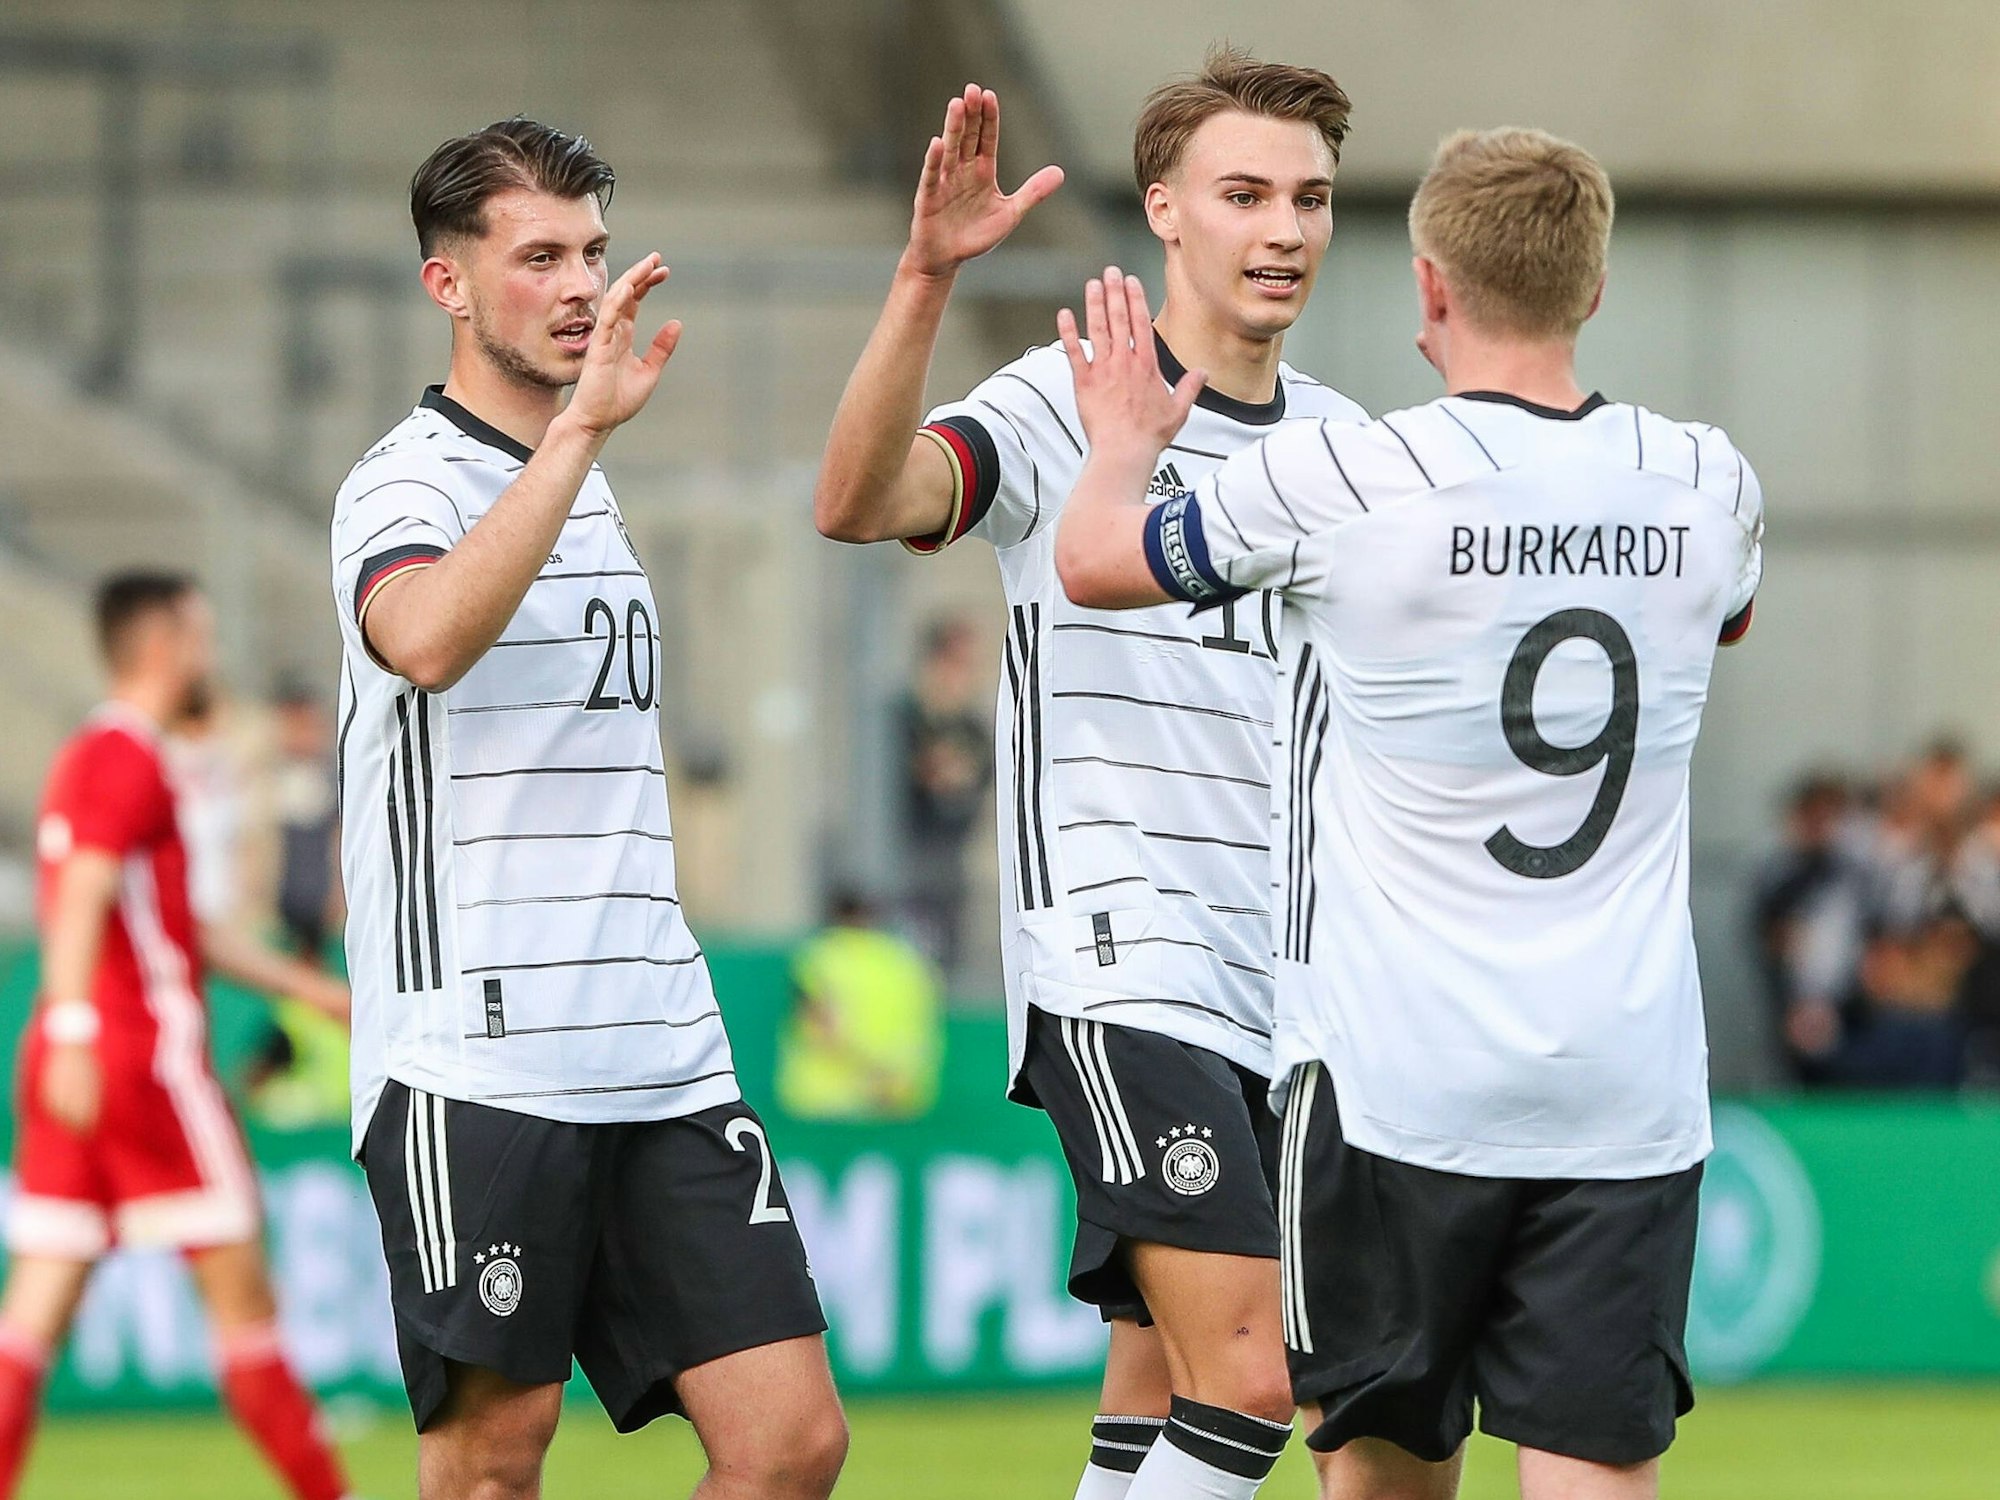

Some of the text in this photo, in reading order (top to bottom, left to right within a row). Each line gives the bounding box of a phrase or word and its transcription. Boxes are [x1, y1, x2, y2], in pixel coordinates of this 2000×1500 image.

[1147, 484, 1189, 498] adida
[1450, 525, 1691, 578] BURKARDT
[583, 597, 654, 712] 20
[1484, 608, 1639, 879] 9
[724, 1116, 791, 1225] 2
